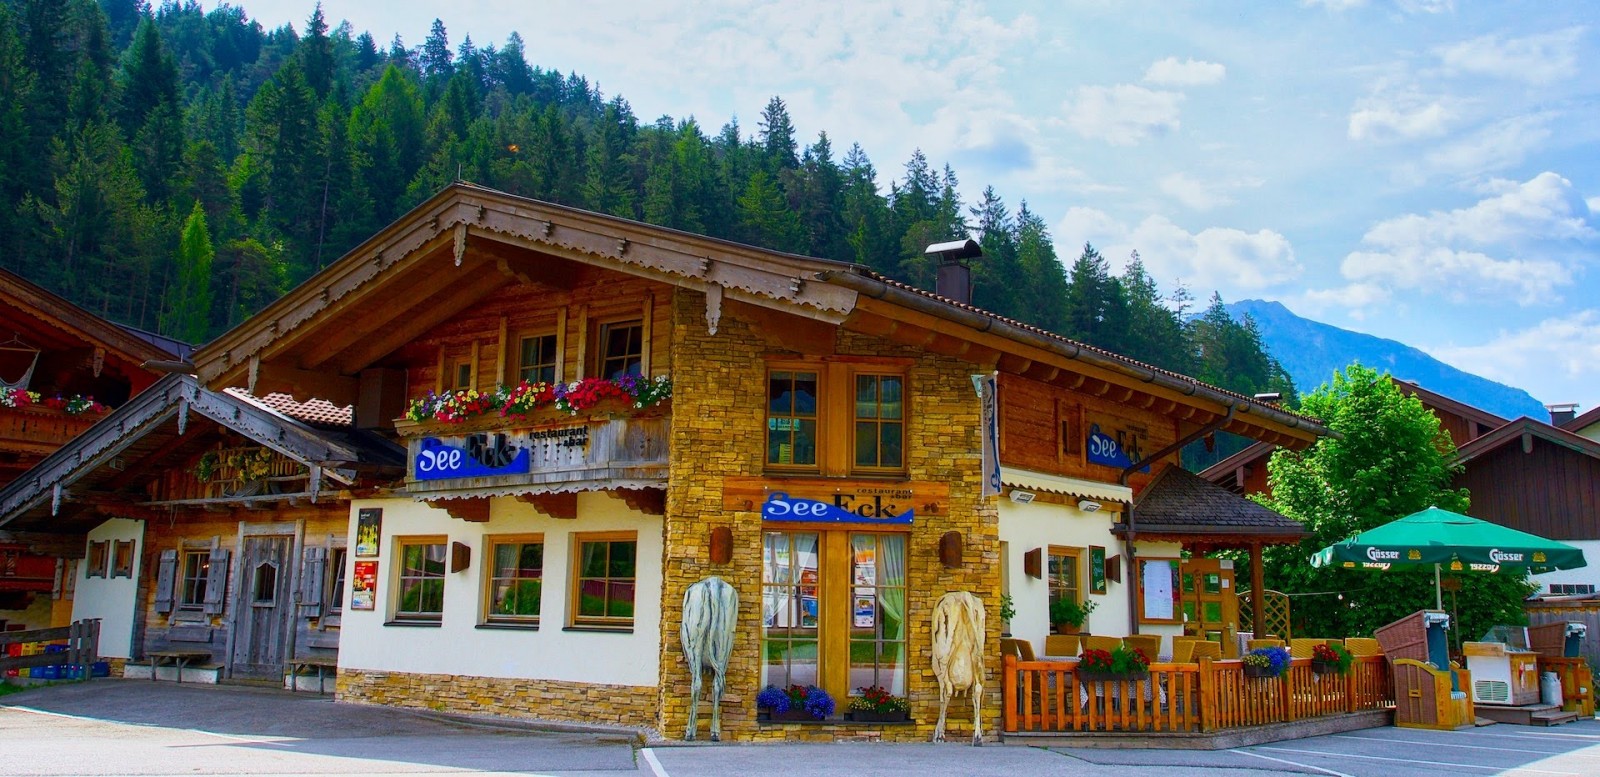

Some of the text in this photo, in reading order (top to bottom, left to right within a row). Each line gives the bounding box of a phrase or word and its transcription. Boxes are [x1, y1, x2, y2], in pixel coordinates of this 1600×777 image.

[529, 425, 588, 439] restaurant
[1091, 424, 1117, 459] See
[419, 432, 517, 472] See Eck
[767, 491, 896, 517] See Eck
[1366, 546, 1400, 561] Gösser
[1489, 549, 1524, 564] Gösser
